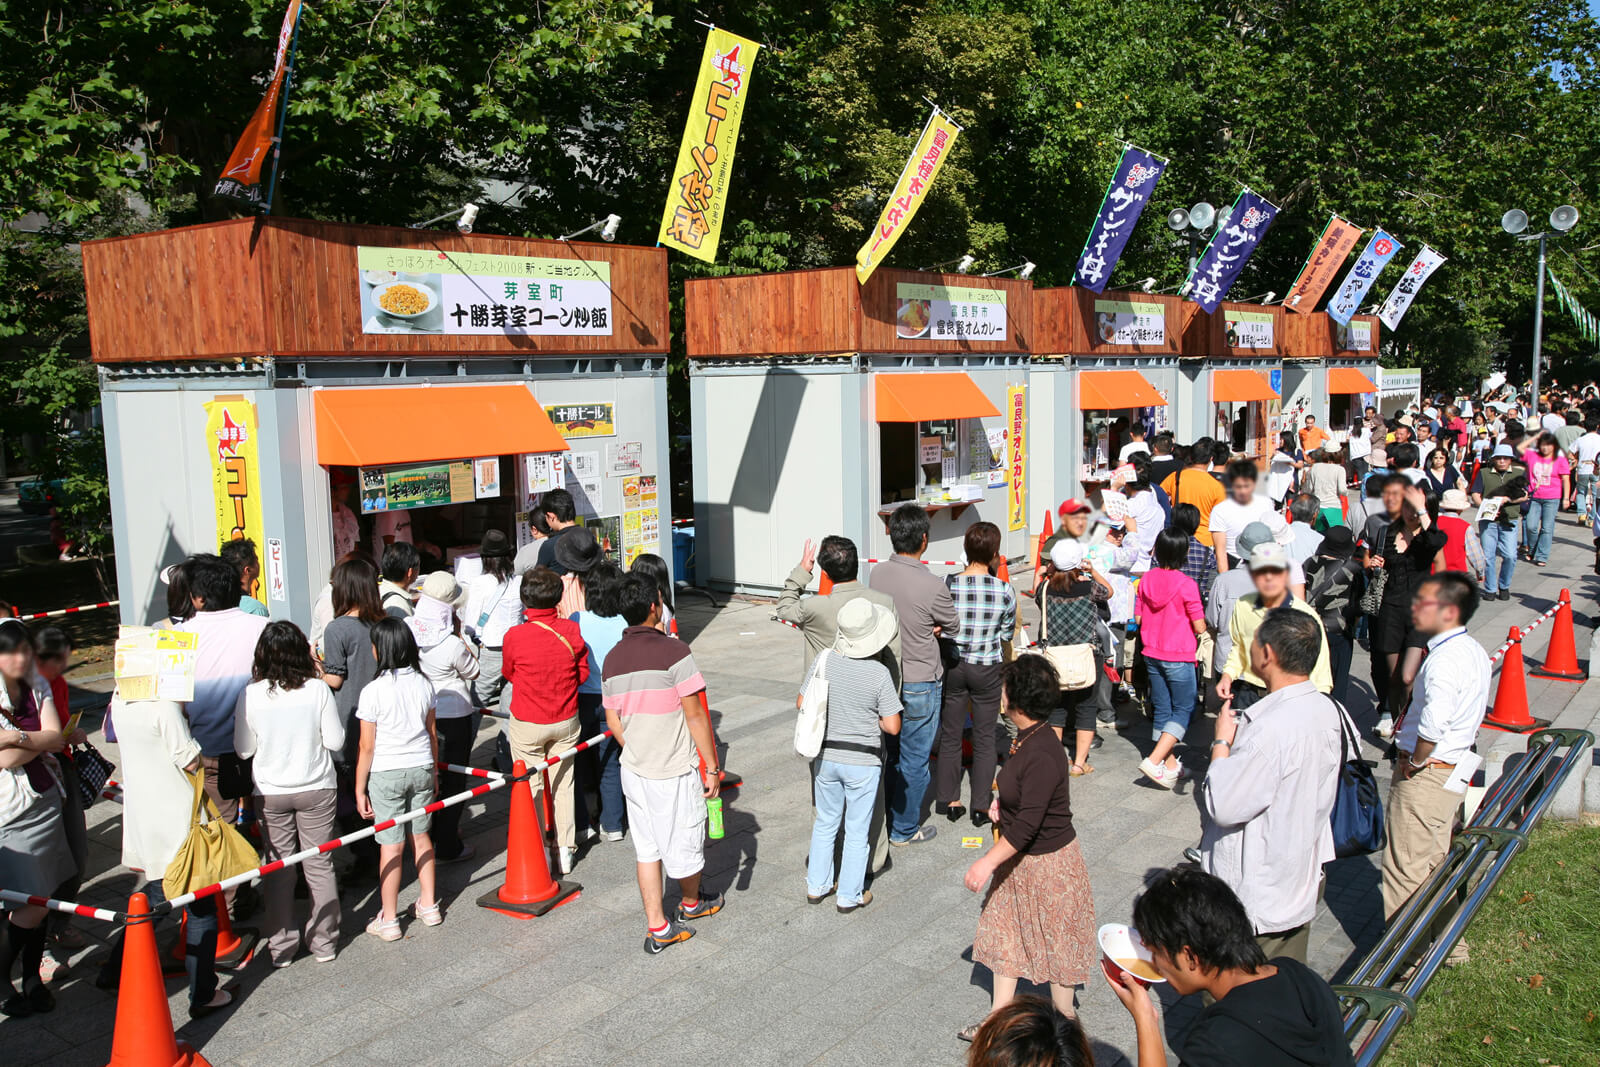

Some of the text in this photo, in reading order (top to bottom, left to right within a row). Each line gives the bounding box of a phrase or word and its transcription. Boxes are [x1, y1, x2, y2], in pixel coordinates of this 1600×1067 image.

[1079, 187, 1143, 283] ザンギ丼
[1192, 225, 1256, 304] ザンギ丼
[504, 281, 563, 302] 芽室町
[450, 303, 608, 329] 十勝芽室コーン炒飯
[951, 304, 988, 318] 富良野市
[936, 319, 1003, 336] 富良野オムカレー
[556, 405, 604, 422] 十勝ビール
[1013, 393, 1023, 505] 富良野オムカレー
[552, 459, 563, 490] ビー
[272, 547, 282, 589] ビール
